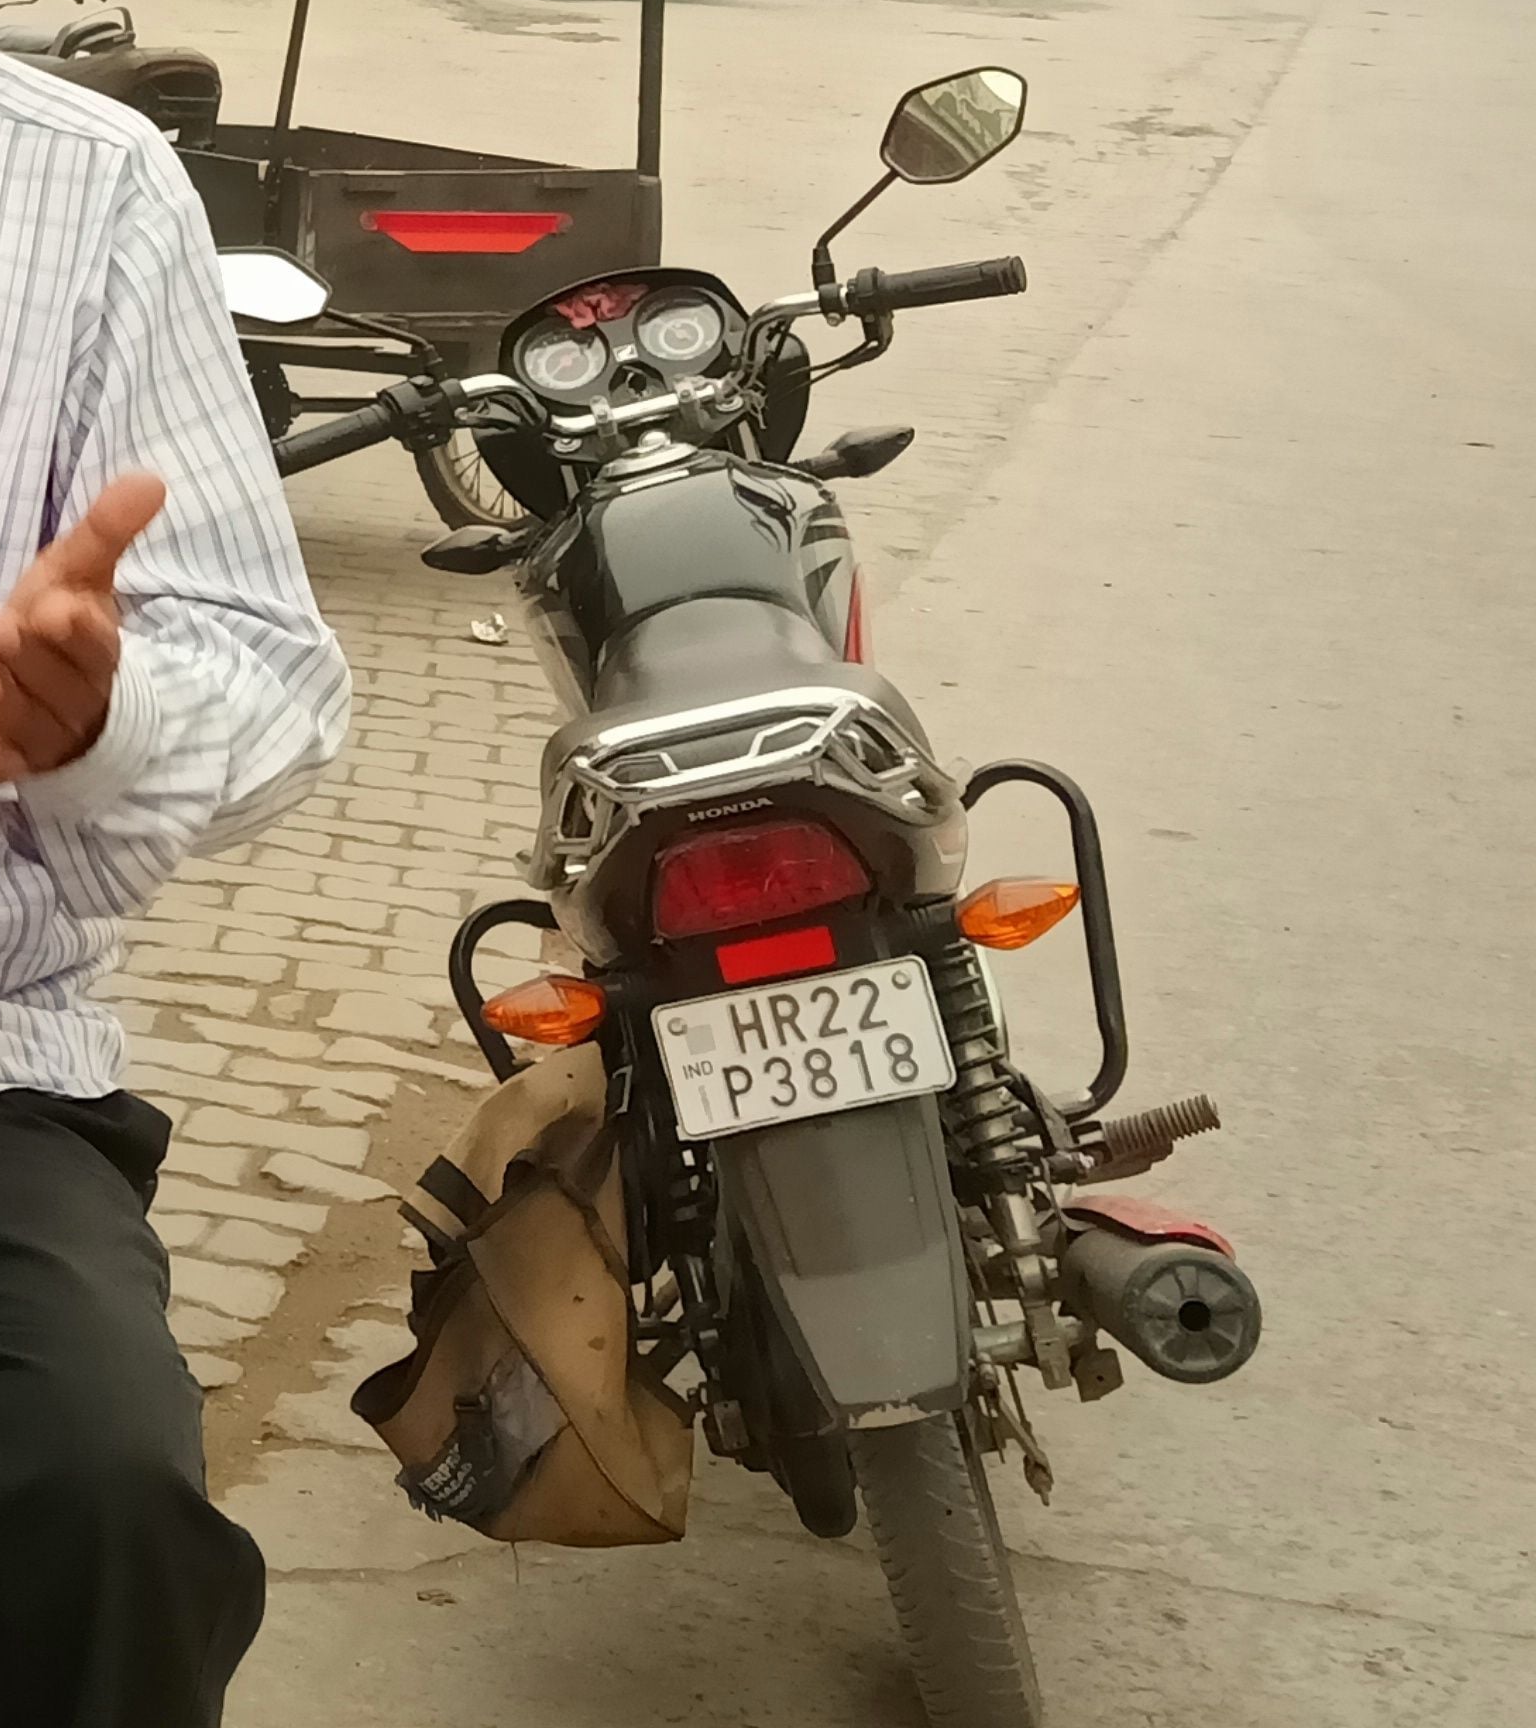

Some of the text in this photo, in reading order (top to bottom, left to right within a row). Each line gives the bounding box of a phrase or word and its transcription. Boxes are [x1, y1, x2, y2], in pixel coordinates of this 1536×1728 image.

[688, 796, 774, 823] HONDA
[729, 978, 888, 1054] HR22
[682, 1060, 714, 1081] IND
[721, 1032, 920, 1119] P3818
